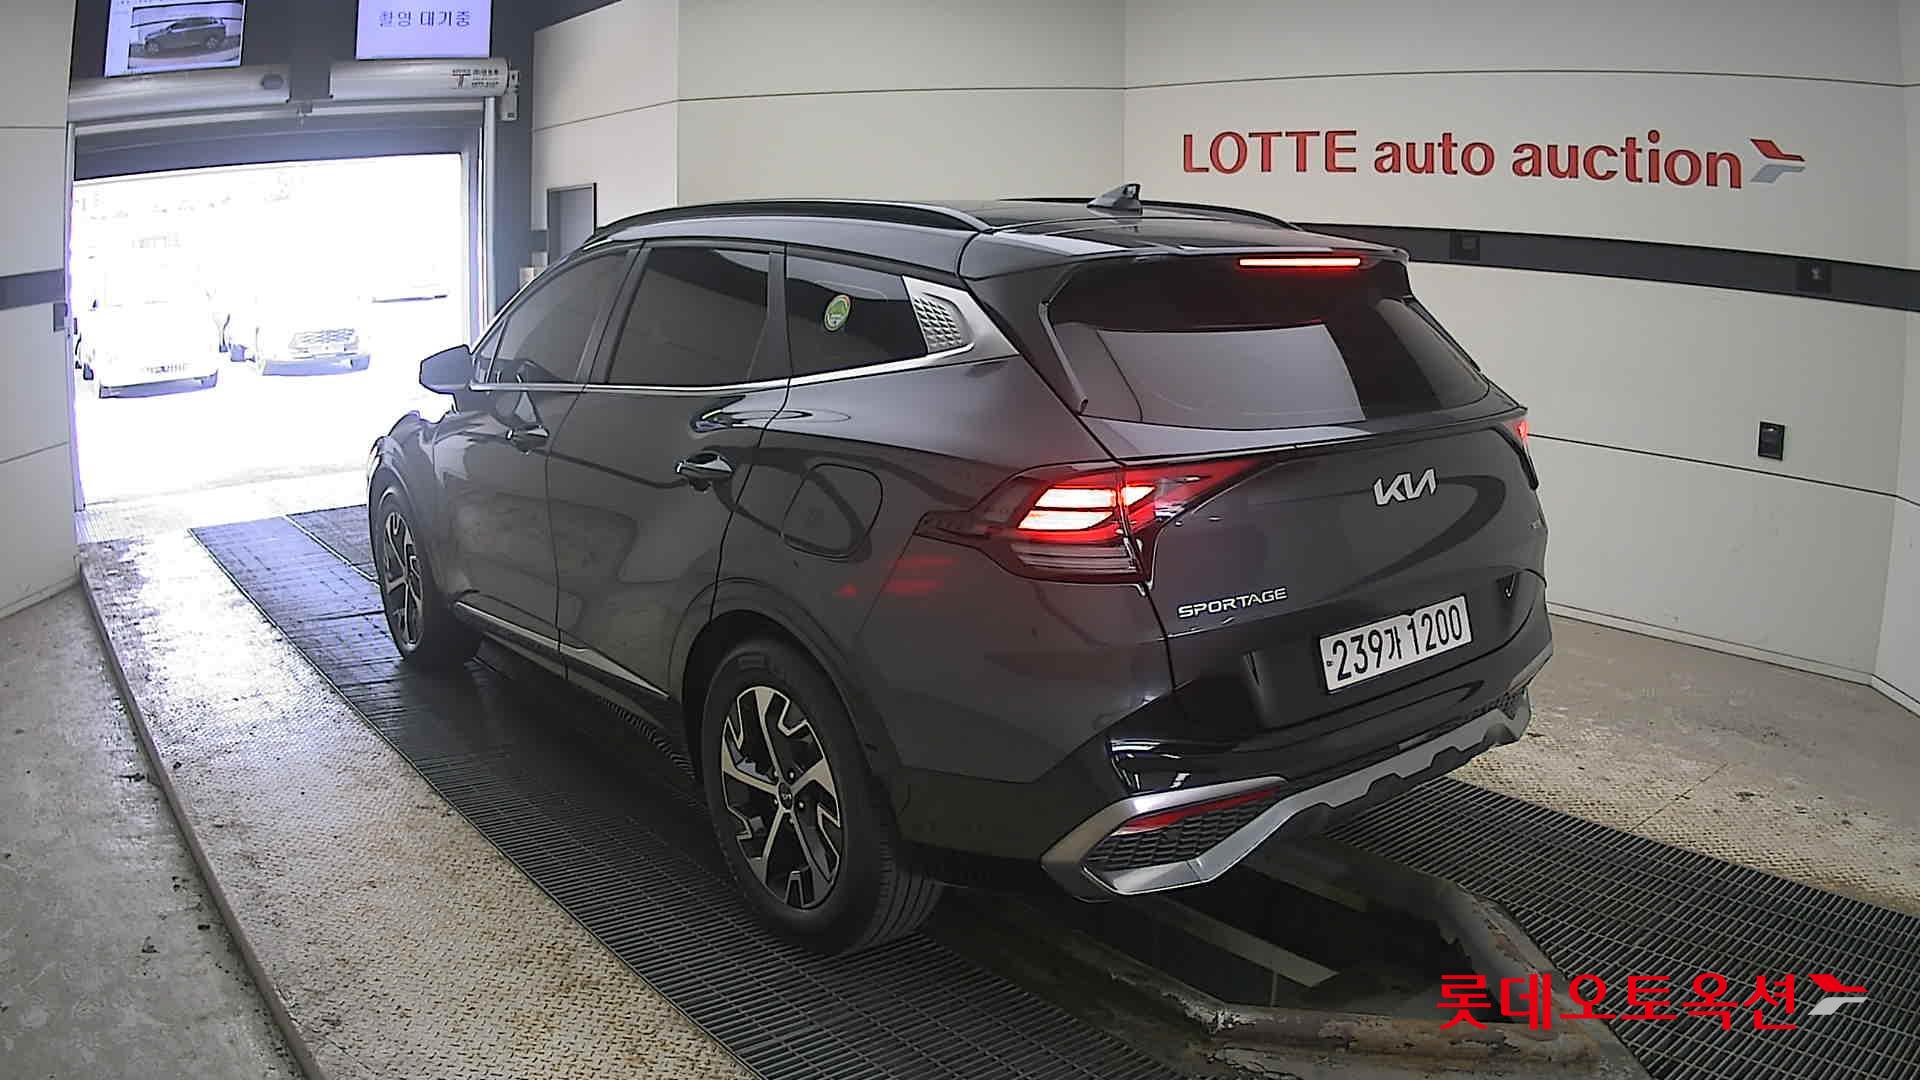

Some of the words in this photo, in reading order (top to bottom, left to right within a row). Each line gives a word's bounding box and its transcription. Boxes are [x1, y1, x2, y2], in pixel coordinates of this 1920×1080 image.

[1183, 130, 1357, 174] LOTTE
[1373, 132, 1495, 176] auto
[1511, 129, 1742, 189] auction
[1374, 468, 1436, 506] KIA
[1177, 586, 1288, 619] SPORTAGE
[1332, 626, 1402, 681] 239가
[1407, 605, 1462, 655] 1200
